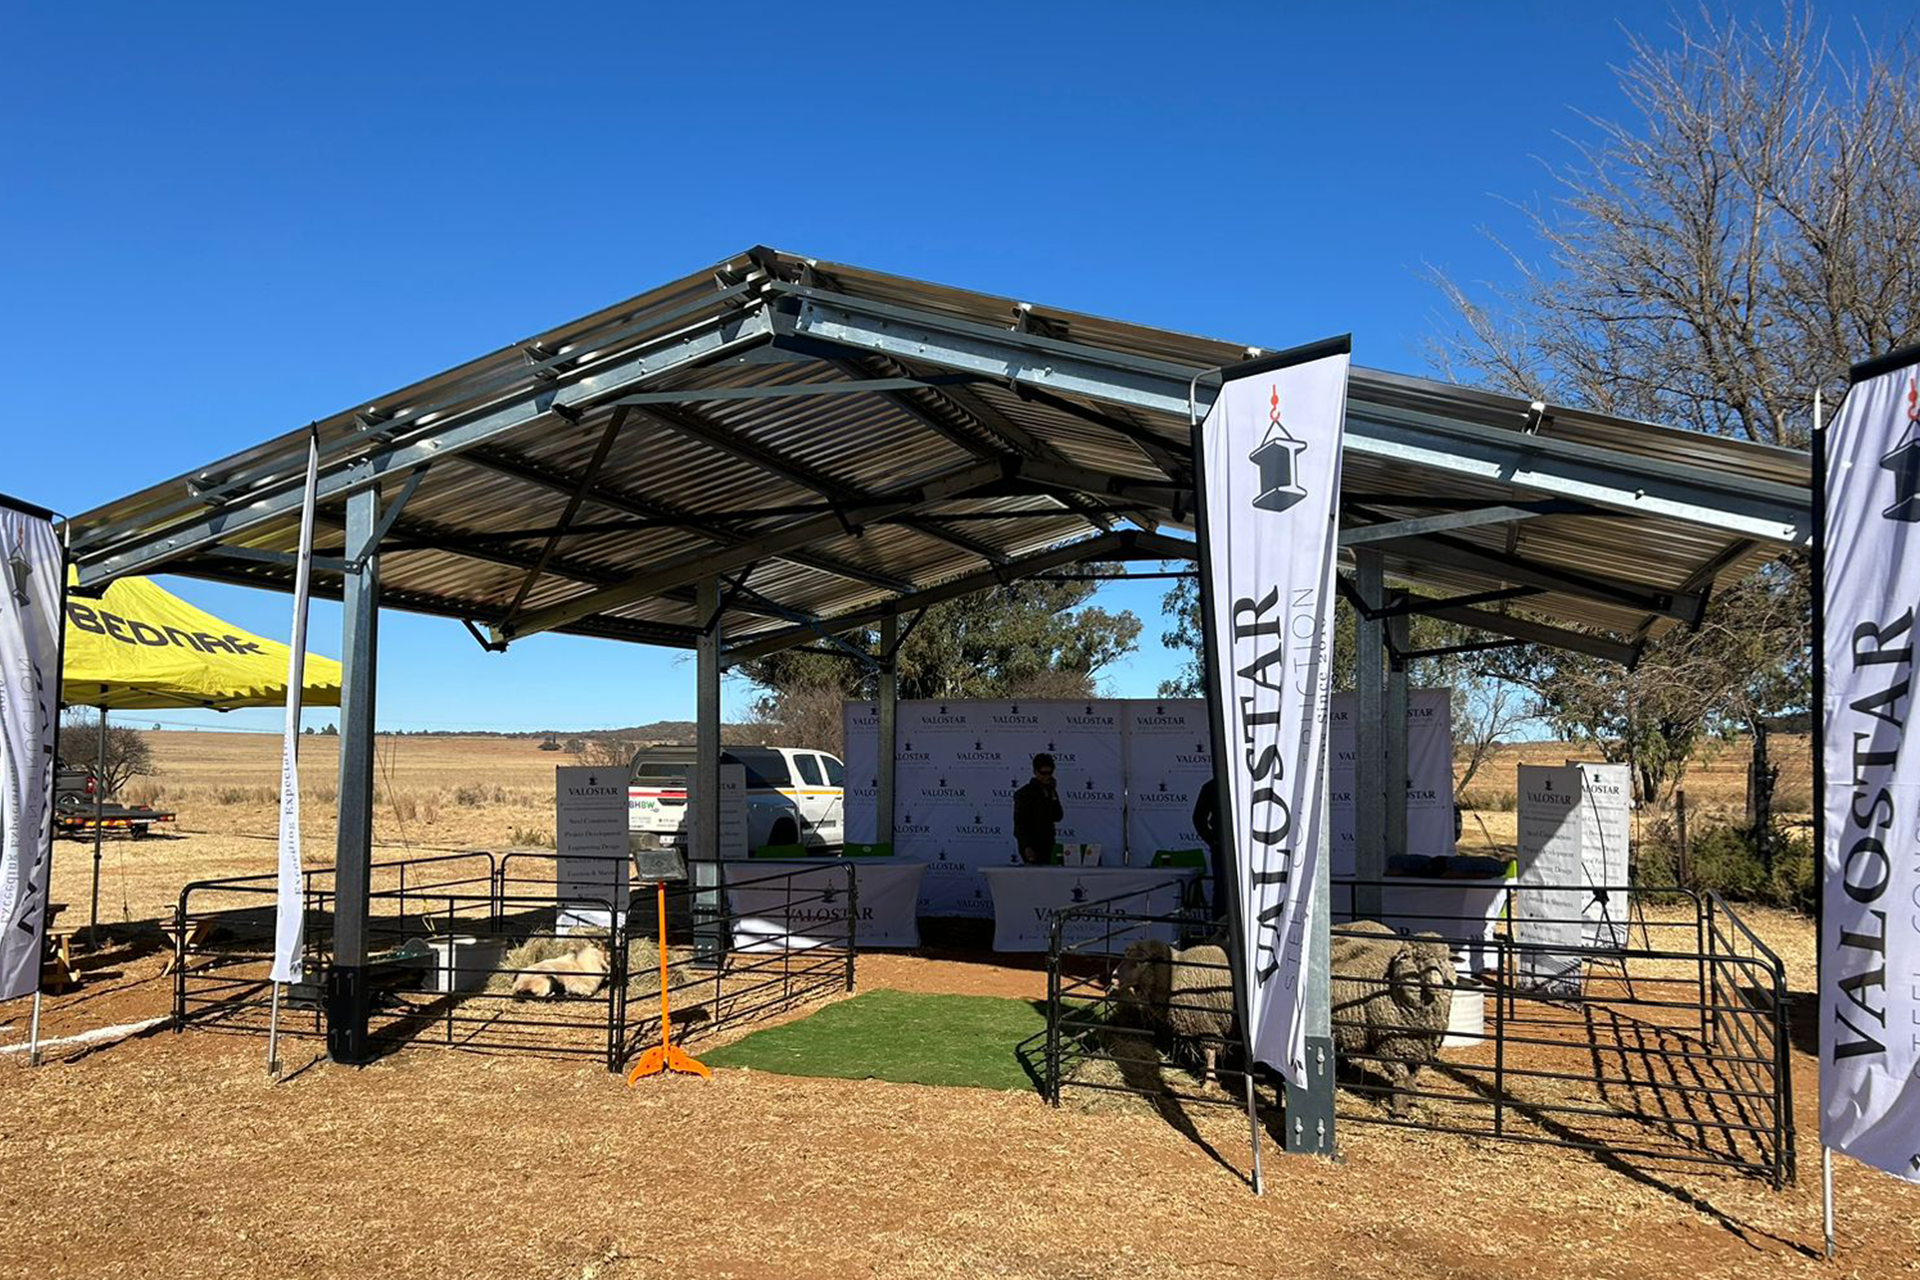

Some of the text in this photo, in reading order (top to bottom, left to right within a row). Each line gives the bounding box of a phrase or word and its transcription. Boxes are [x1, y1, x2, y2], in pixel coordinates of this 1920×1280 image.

[922, 716, 966, 724] VALOSTAR
[993, 715, 1038, 724] VALOSTAR
[1066, 716, 1114, 725] VALOSTAR
[1137, 716, 1185, 725] VALOSTAR
[957, 752, 1001, 761] VALOSTAR
[568, 787, 618, 796] VALOSTAR
[1233, 585, 1292, 989] VALOSTAR
[922, 789, 966, 798] VALOSTAR
[1066, 791, 1114, 801] VALOSTAR
[1139, 793, 1188, 802] VALOSTAR
[1527, 792, 1572, 805] VALOSTAR
[956, 825, 1001, 835] VALOSTAR
[1832, 606, 1915, 1066] VALOSTAR
